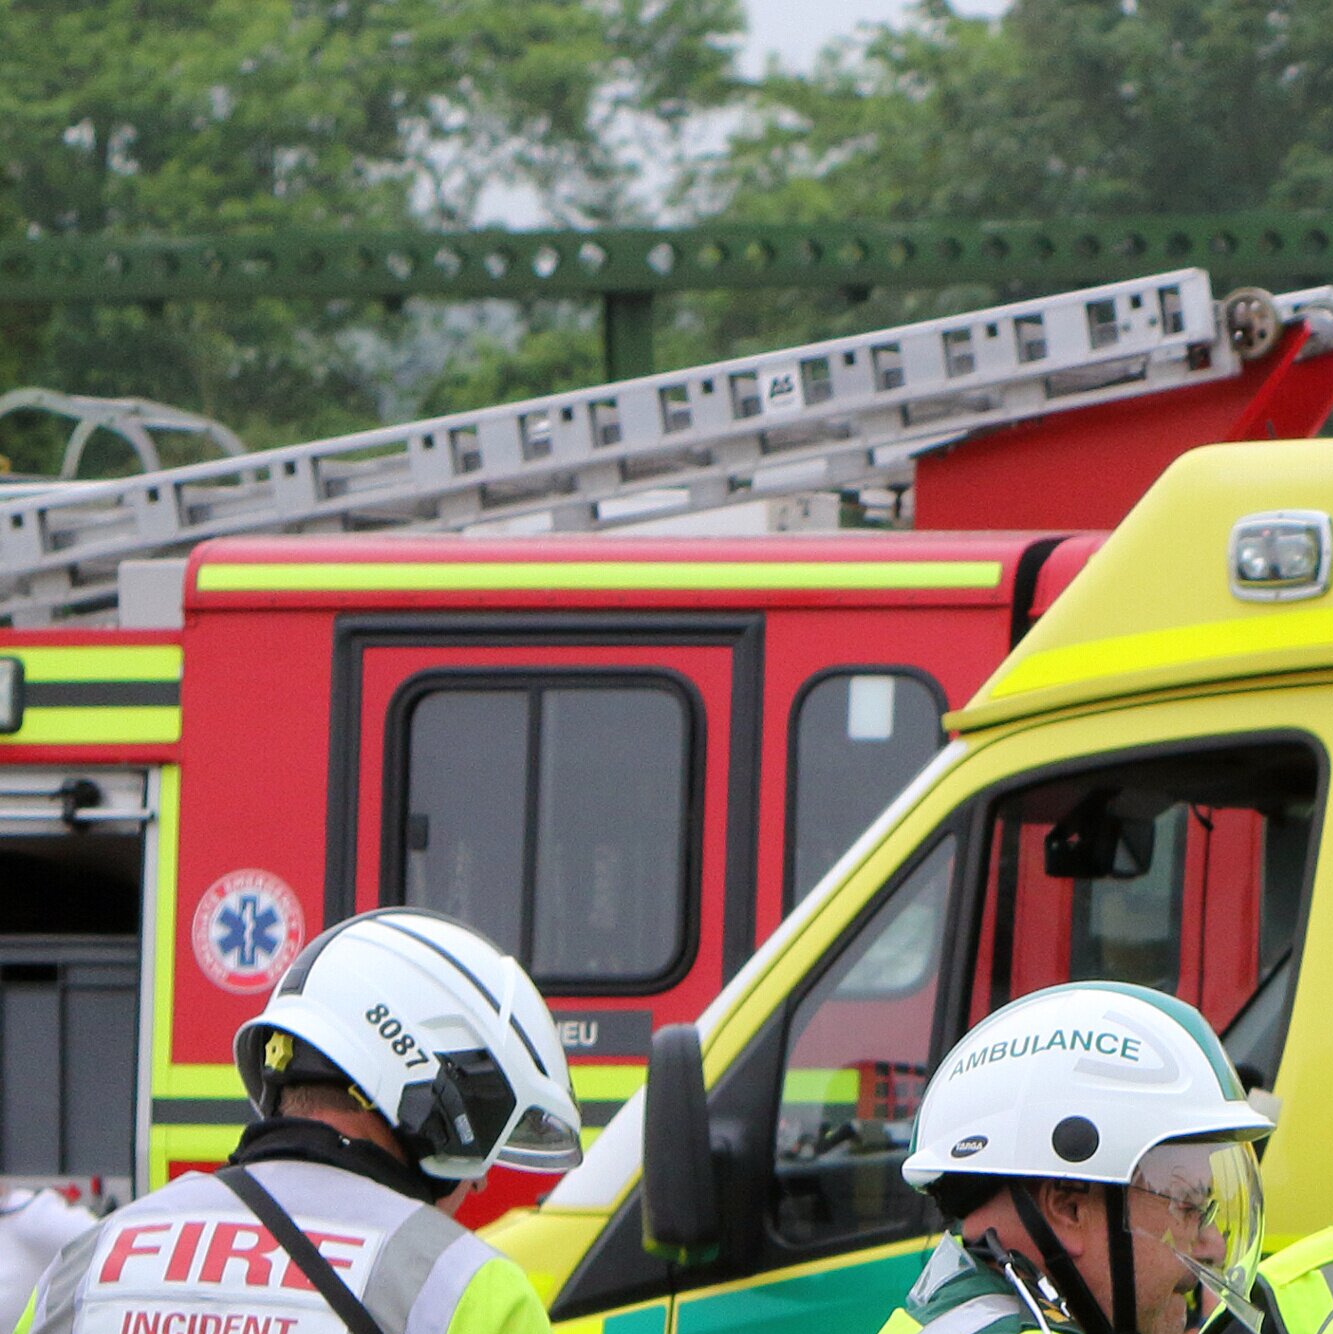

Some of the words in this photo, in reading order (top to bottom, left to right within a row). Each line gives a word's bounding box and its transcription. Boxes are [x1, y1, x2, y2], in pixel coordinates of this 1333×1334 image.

[365, 1003, 429, 1069] 8087
[556, 1021, 599, 1045] EU
[949, 1029, 1142, 1081] AMBULANCE
[98, 1222, 366, 1293] FIRE
